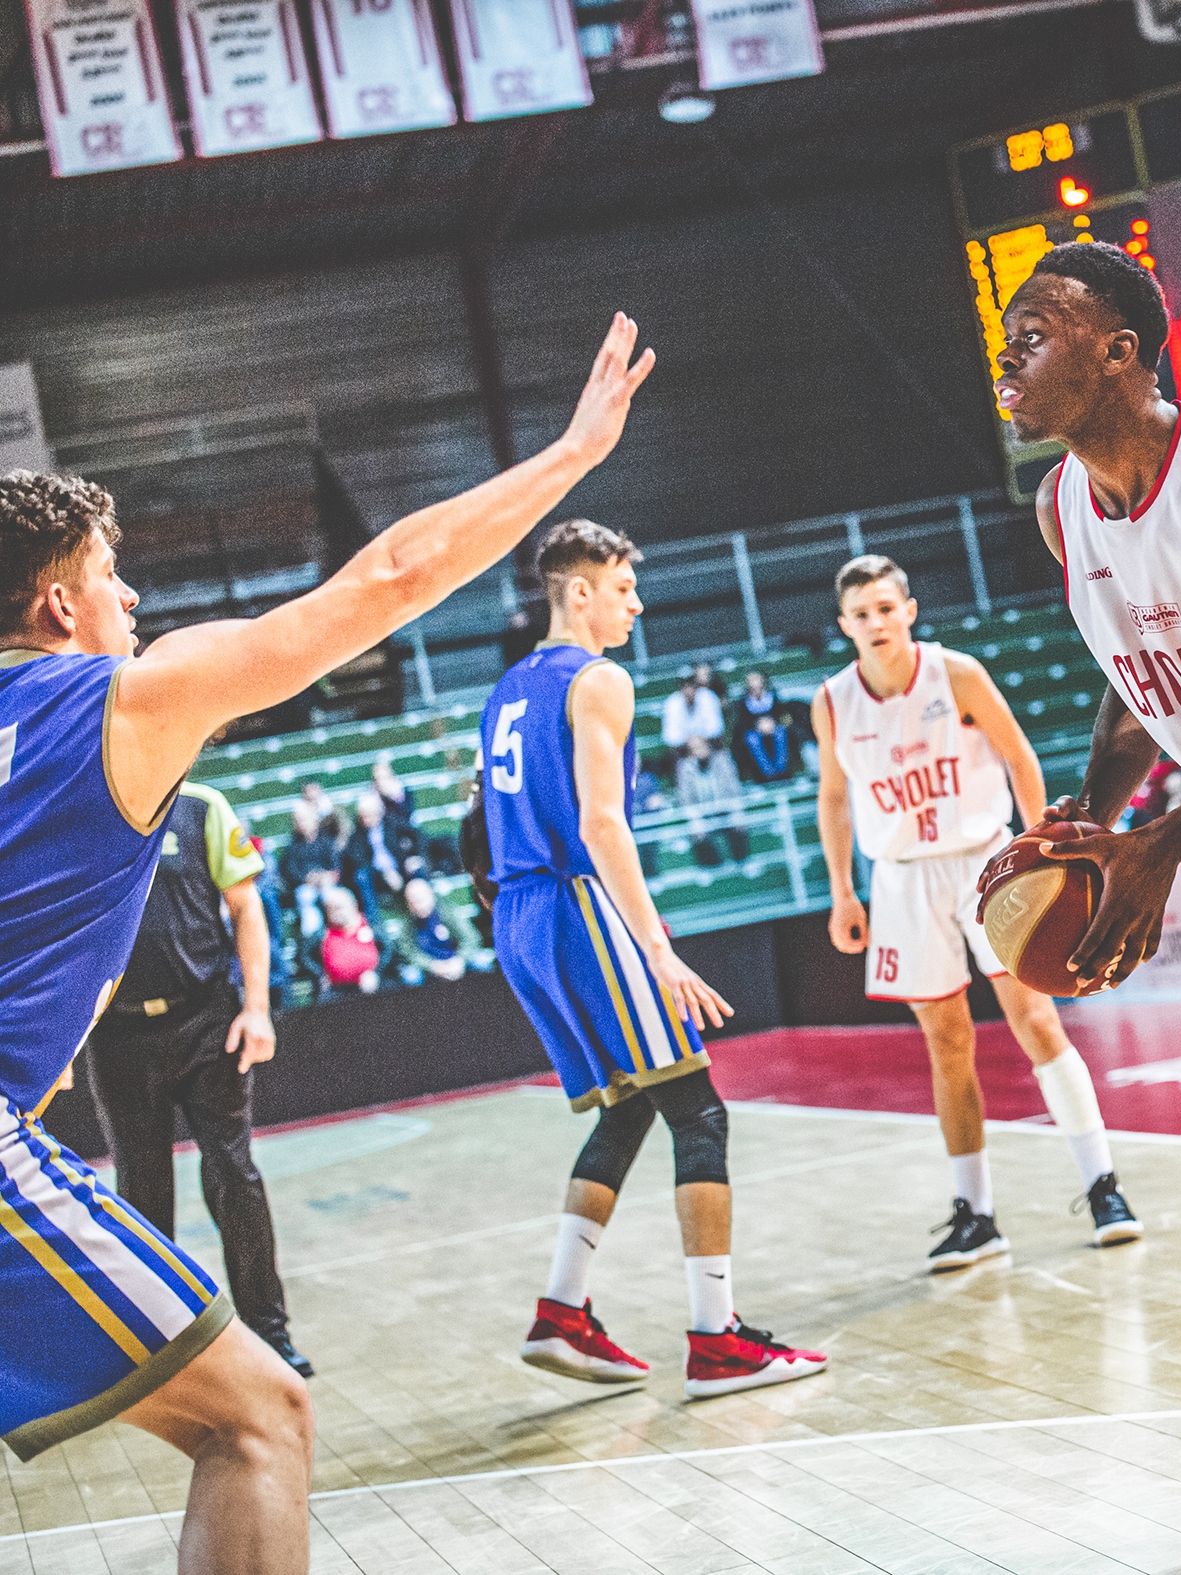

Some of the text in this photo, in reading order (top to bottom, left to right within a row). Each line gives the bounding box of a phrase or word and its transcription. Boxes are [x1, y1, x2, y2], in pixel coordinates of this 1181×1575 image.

[491, 698, 528, 795] 5
[870, 757, 961, 815] CHOLET
[916, 807, 938, 843] 15
[875, 946, 899, 983] 15
